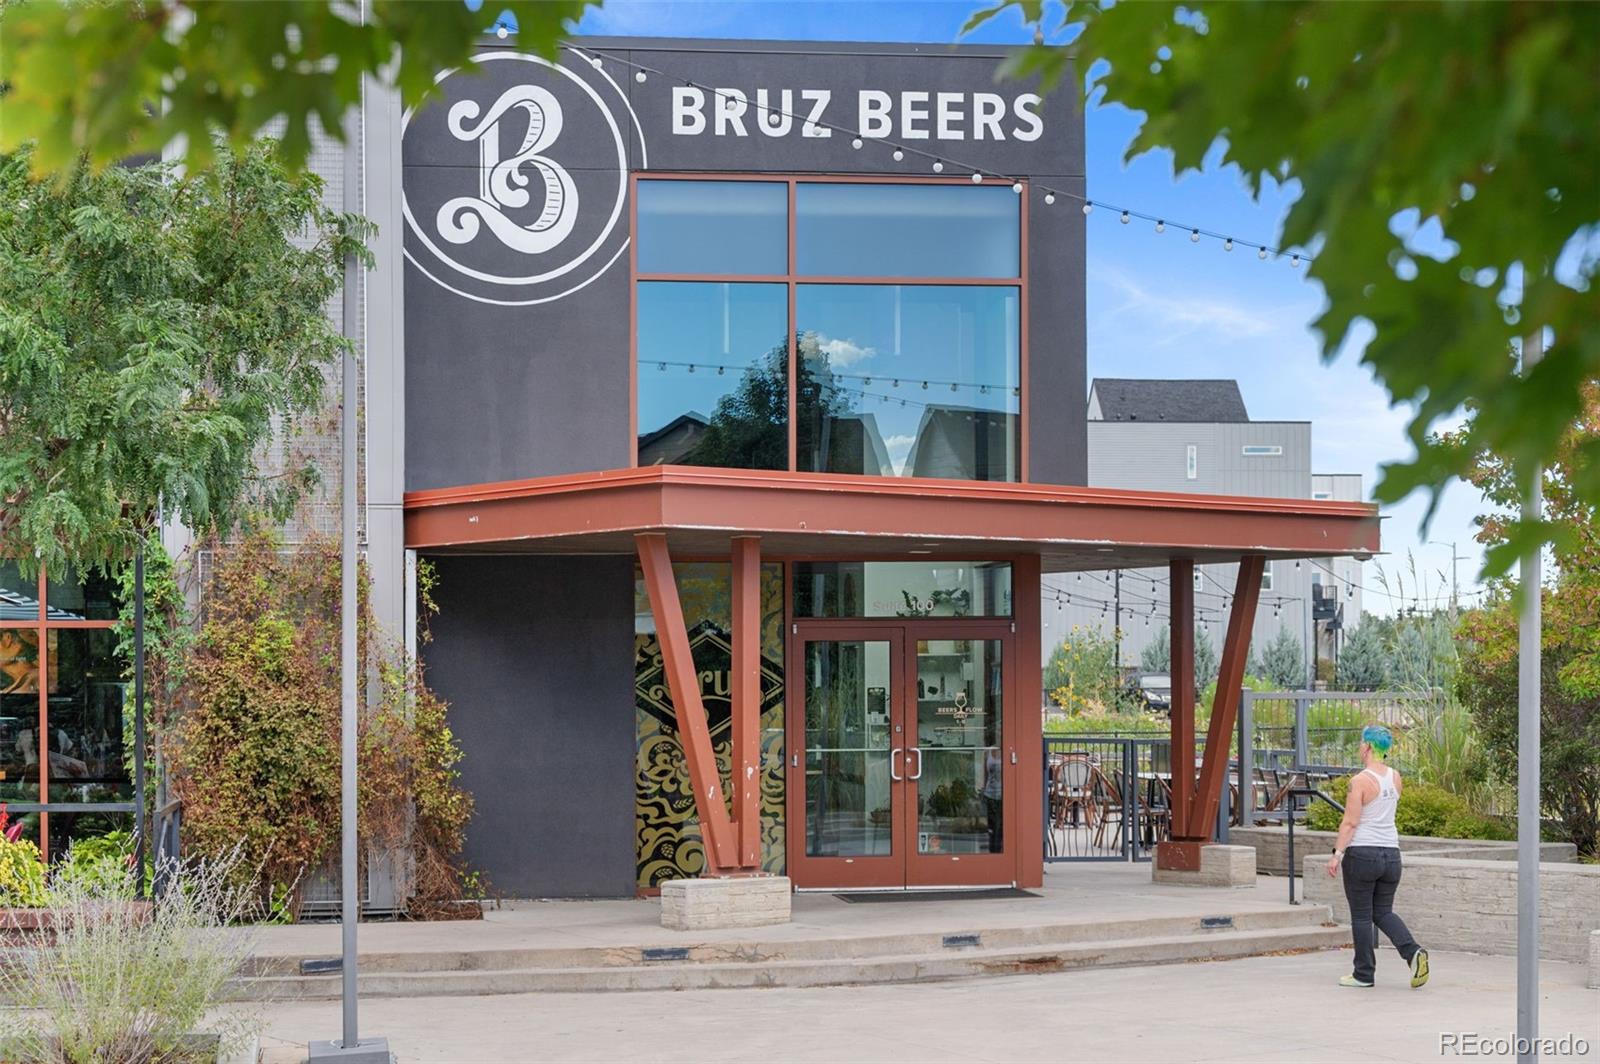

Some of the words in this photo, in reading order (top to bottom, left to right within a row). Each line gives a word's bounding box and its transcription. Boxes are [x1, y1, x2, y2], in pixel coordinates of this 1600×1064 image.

[672, 86, 832, 138] BRUZ
[858, 90, 1044, 142] BEERS
[911, 600, 934, 611] 100
